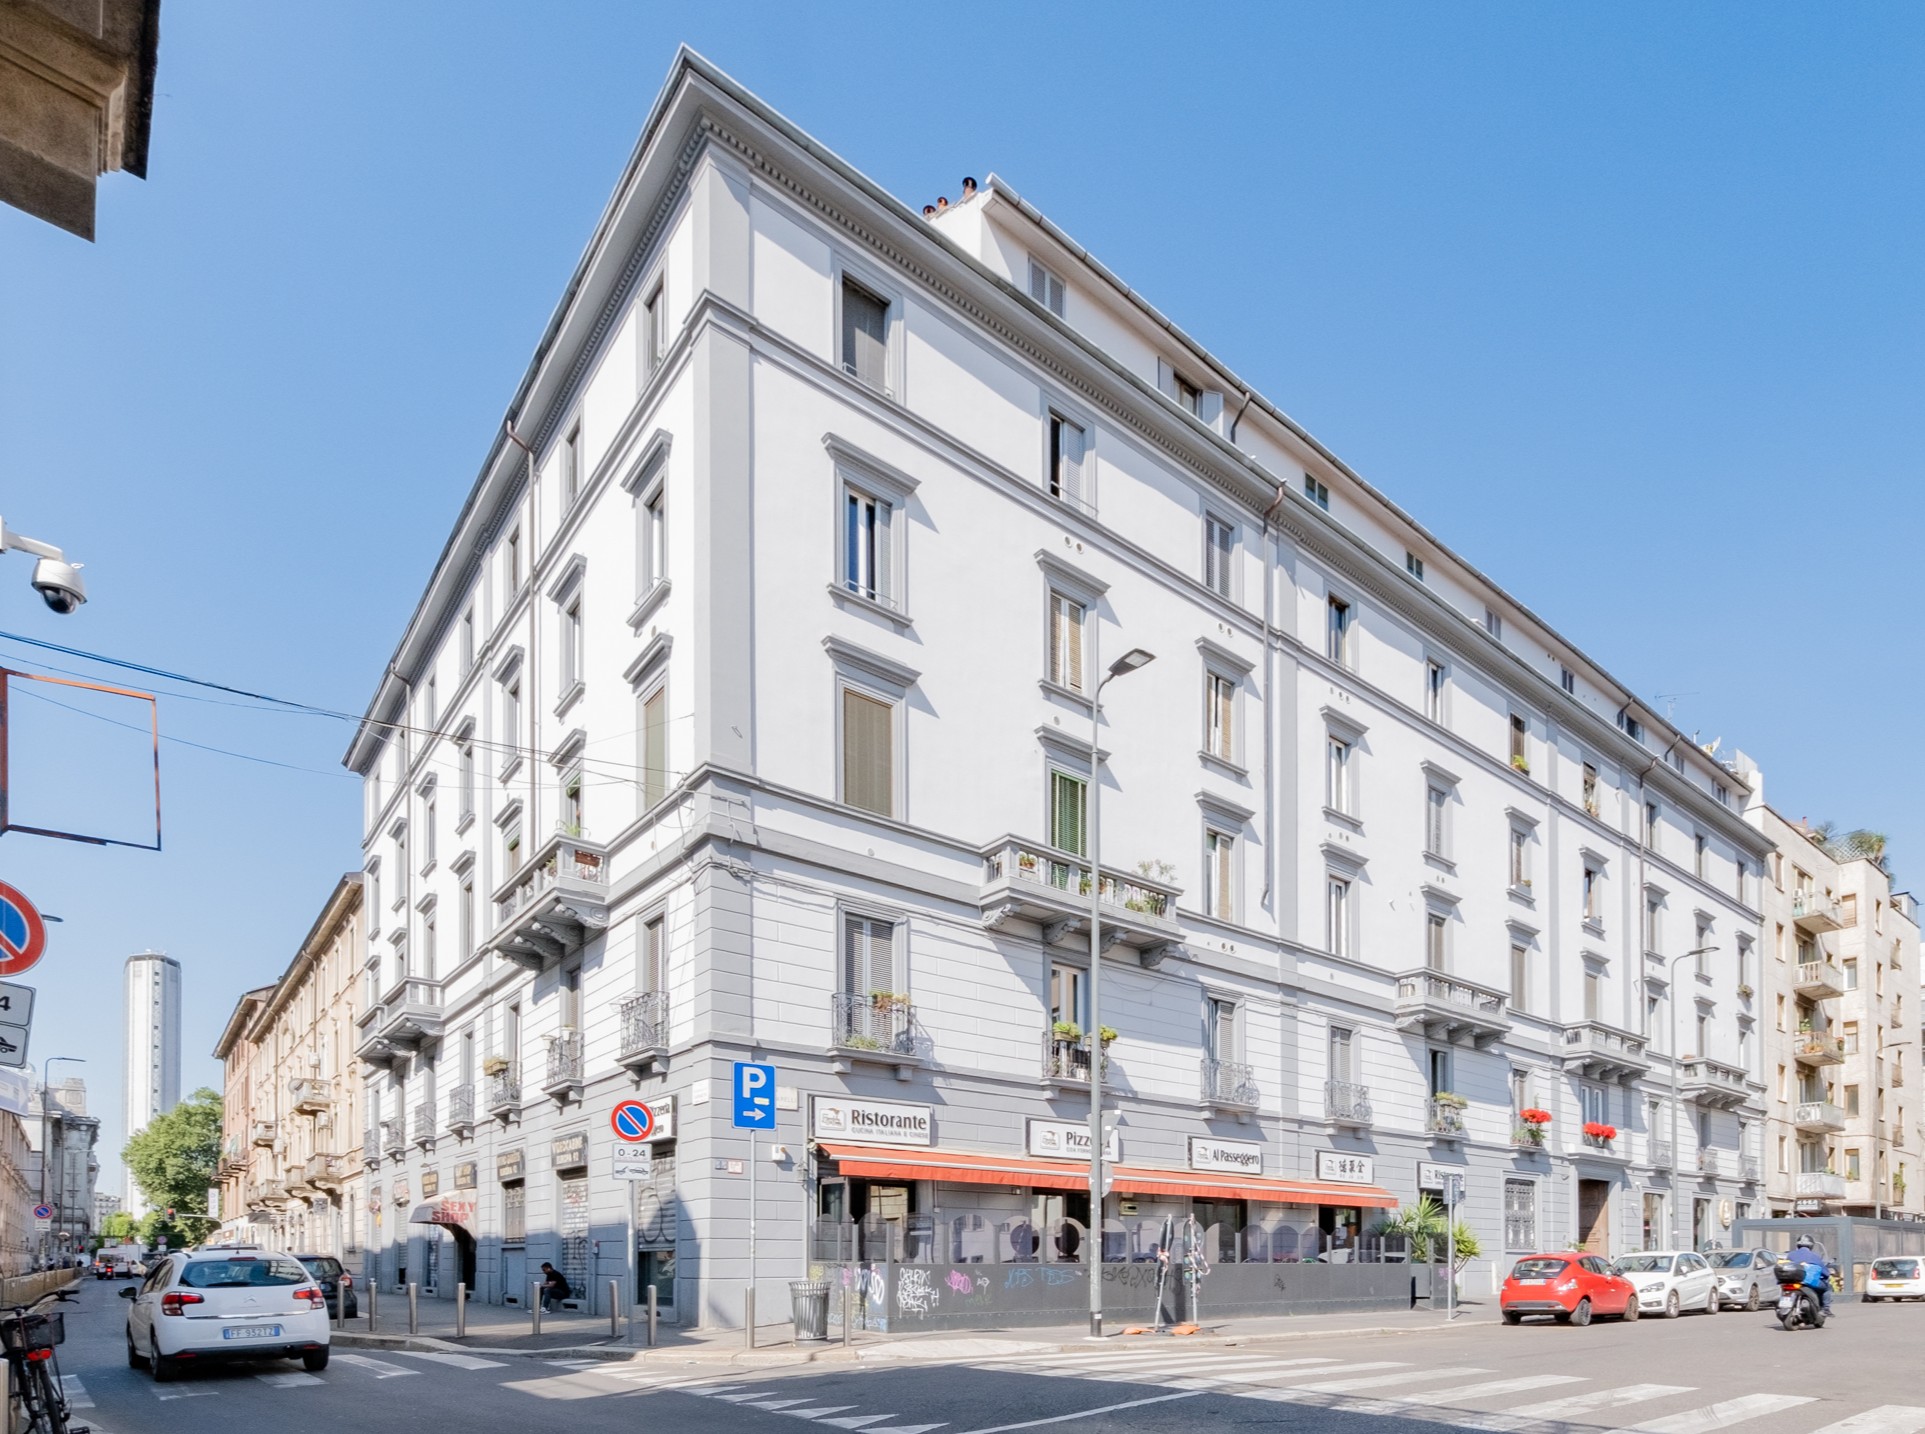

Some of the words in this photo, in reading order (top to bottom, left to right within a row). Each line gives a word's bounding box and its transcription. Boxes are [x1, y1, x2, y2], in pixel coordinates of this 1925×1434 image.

[742, 1066, 767, 1098] P
[851, 1109, 927, 1130] Ristorante
[441, 1199, 475, 1213] SEXY
[432, 1211, 469, 1224] SHOP
